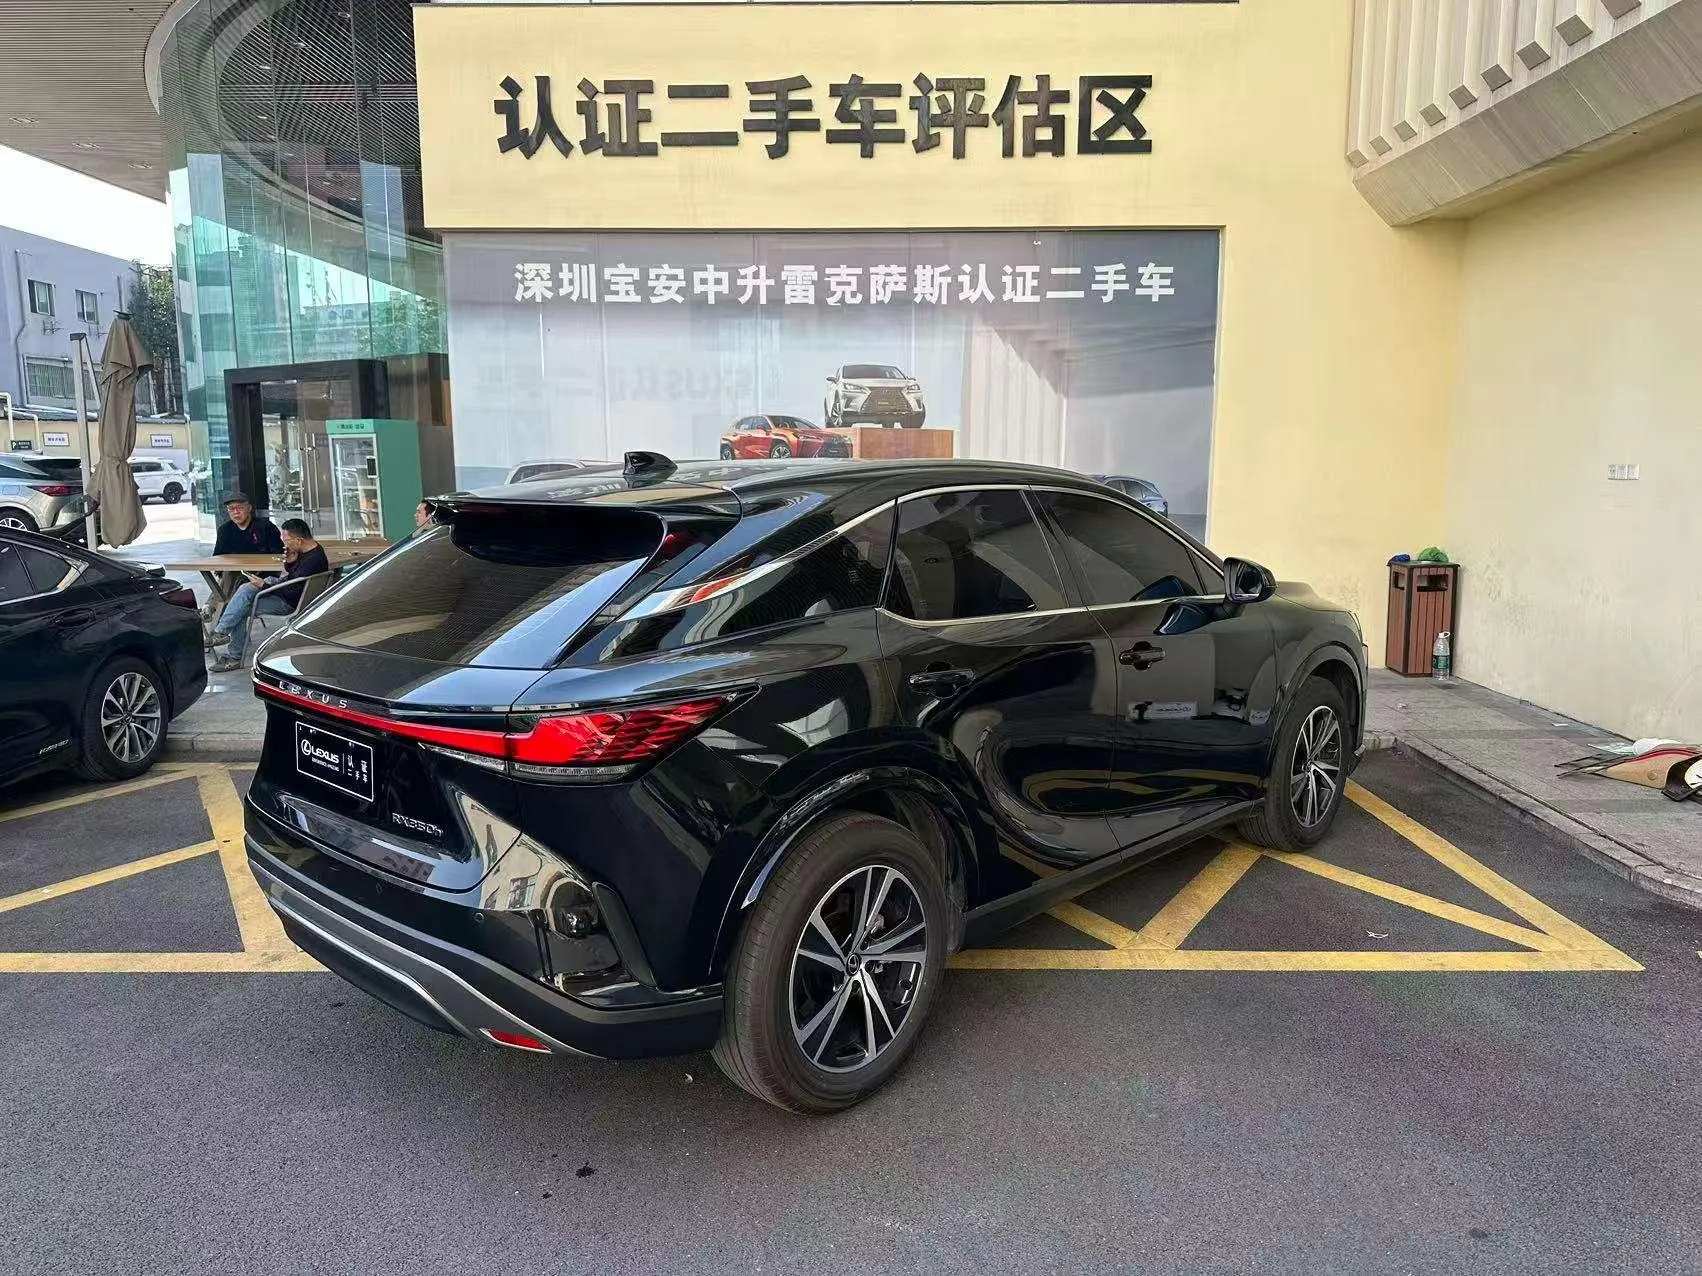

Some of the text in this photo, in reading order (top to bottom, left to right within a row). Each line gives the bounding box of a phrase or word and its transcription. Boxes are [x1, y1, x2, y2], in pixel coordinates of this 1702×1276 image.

[494, 73, 1153, 159] 认证二手车评估区
[513, 262, 1176, 305] 深圳宝安中升雷克萨斯认证二手车
[279, 681, 348, 709] LEXUS
[312, 746, 339, 764] LEXUS
